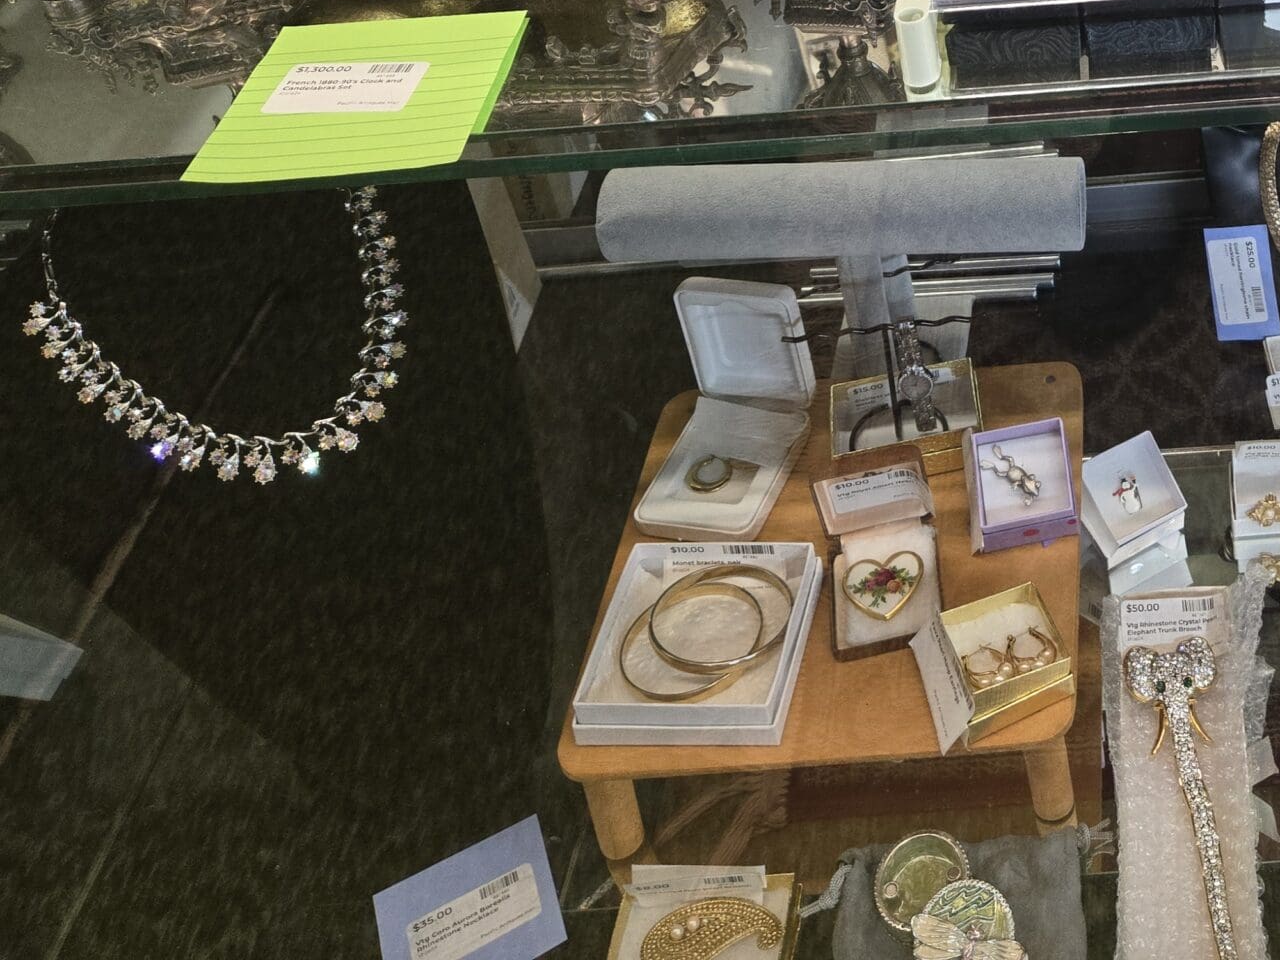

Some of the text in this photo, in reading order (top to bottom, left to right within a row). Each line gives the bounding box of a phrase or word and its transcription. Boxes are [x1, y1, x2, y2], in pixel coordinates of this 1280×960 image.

[296, 65, 353, 74] $1,300.00
[1245, 241, 1256, 269] $25.00
[852, 382, 884, 395] $15.00
[834, 479, 870, 491] $10.00
[669, 546, 705, 554] $10.00
[1126, 603, 1160, 613] $50.00
[1139, 620, 1177, 628] Rhinestone
[1177, 617, 1201, 626] Crystal
[1127, 628, 1157, 636] Elephant
[412, 906, 453, 933] $35.00
[415, 892, 511, 946] Vtg Coro Aurora Borealis
[416, 906, 500, 953] Rhinestone Necklace
